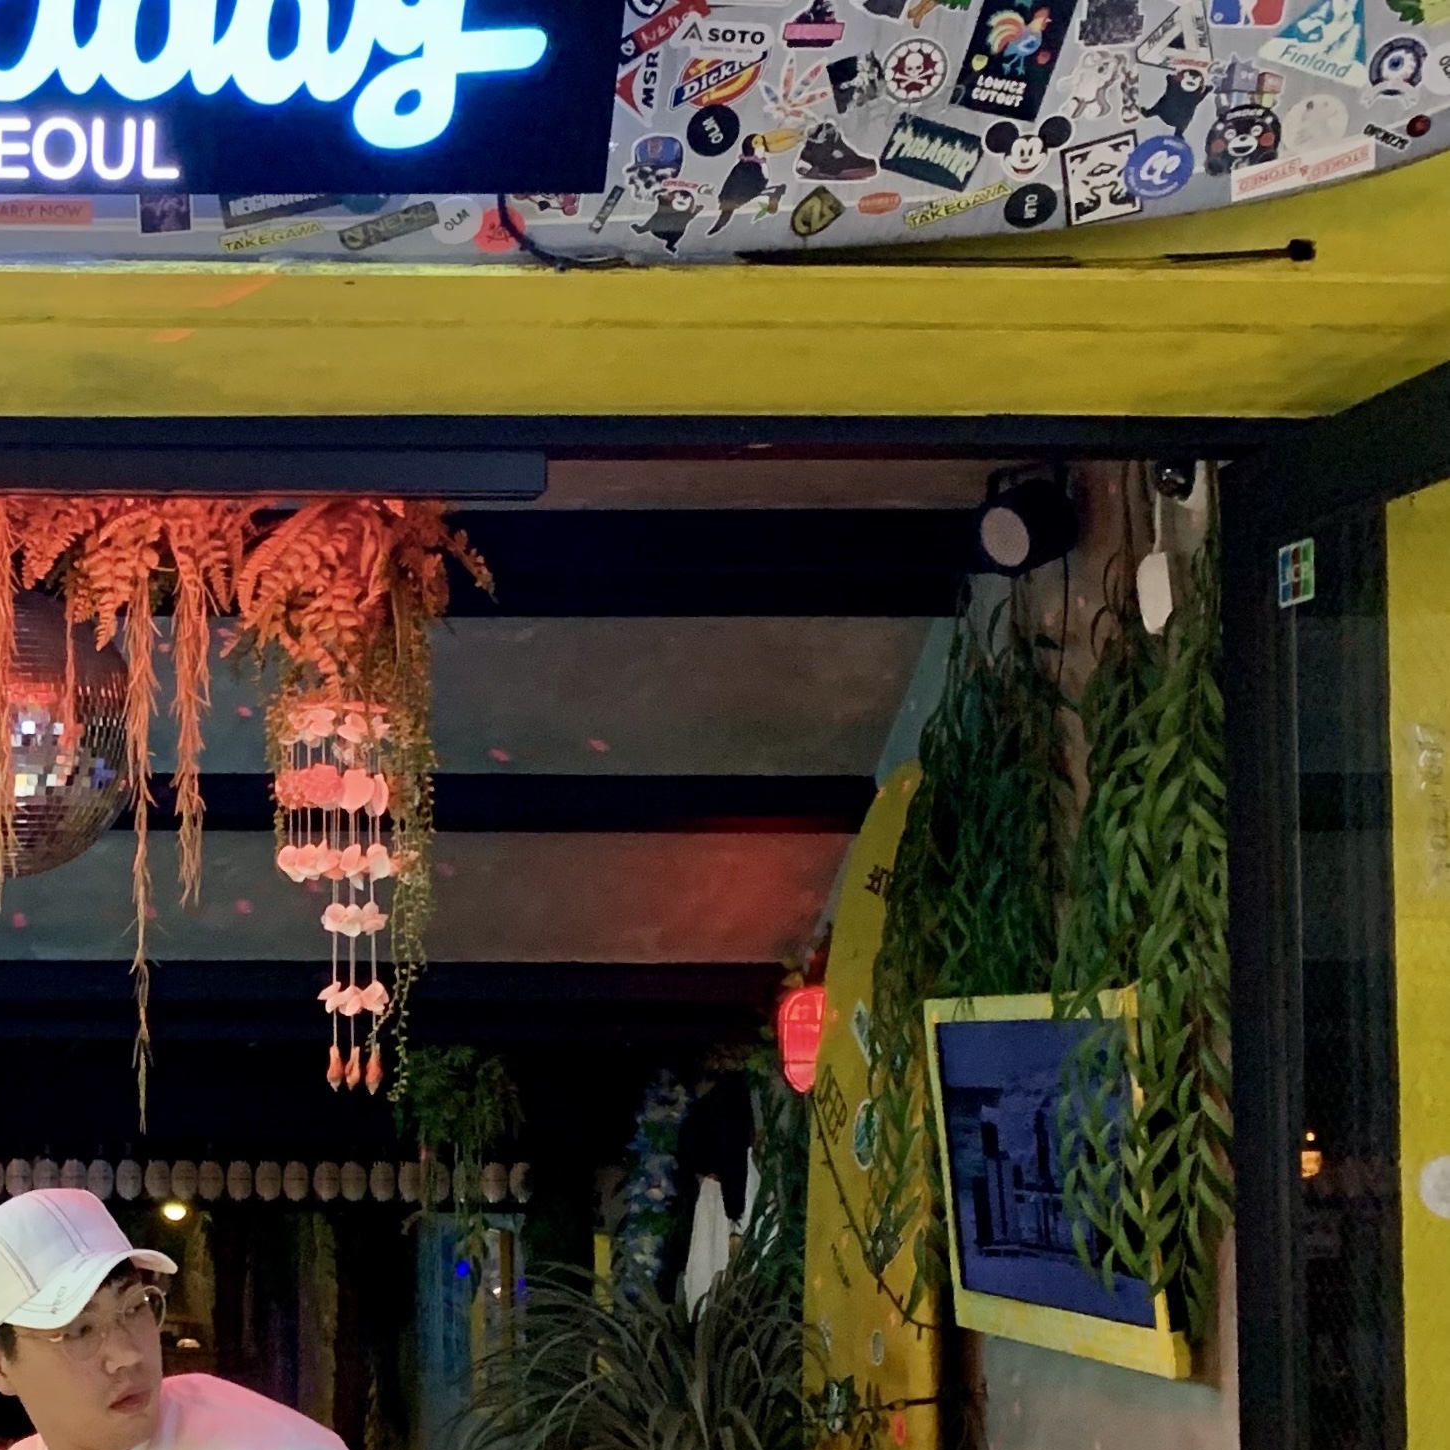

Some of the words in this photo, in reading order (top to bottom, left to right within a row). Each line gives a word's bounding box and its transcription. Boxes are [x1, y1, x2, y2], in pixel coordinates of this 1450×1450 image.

[707, 28, 765, 45] SOTO
[1280, 44, 1353, 79] Finland
[642, 51, 661, 109] MSR
[971, 87, 1024, 107] CUTOUT
[39, 203, 84, 218] NOW
[224, 222, 321, 252] TAKEGAWA
